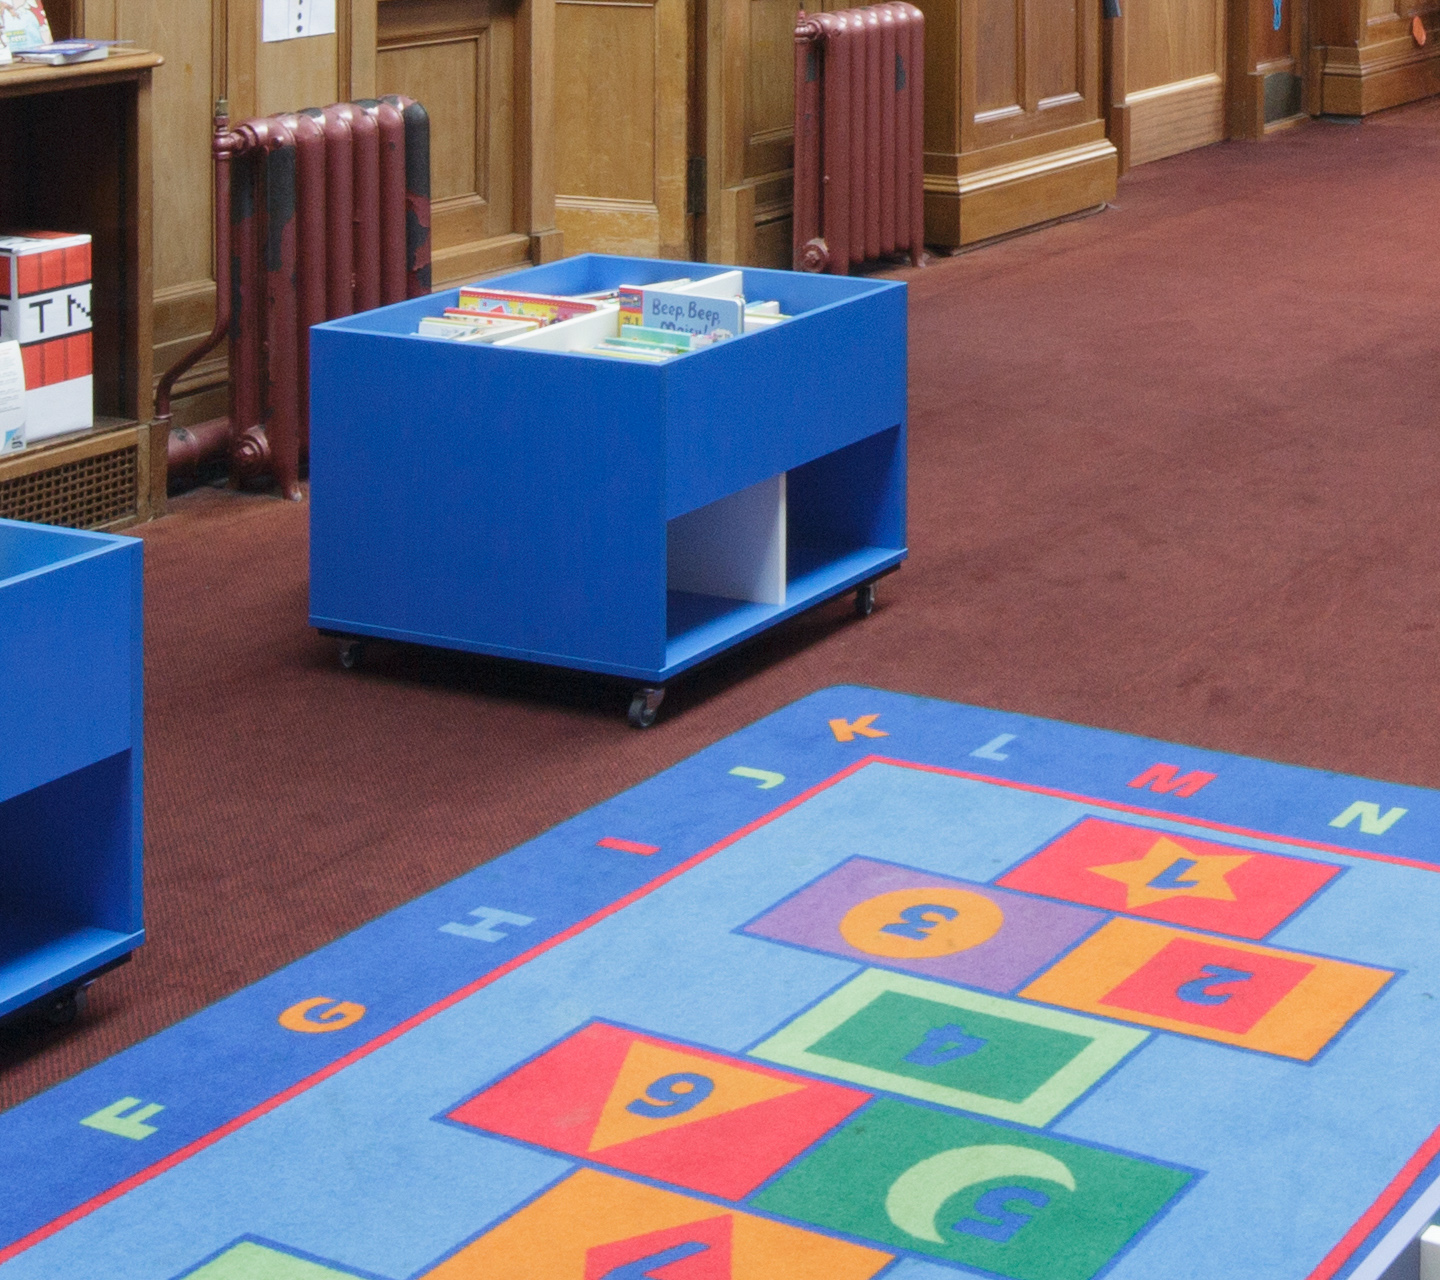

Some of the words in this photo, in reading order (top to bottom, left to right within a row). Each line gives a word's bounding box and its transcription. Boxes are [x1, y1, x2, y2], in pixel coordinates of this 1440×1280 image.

[652, 298, 685, 321] Beep,
[687, 301, 721, 327] Beep,
[827, 713, 891, 744] K
[967, 733, 1019, 762] L
[728, 765, 787, 789] J
[1126, 764, 1219, 799] M
[1328, 800, 1408, 837] N
[595, 836, 662, 857] I
[1145, 856, 1203, 893] 1
[439, 905, 537, 943] H
[880, 902, 962, 941] 3
[1174, 962, 1257, 1008] 2
[277, 996, 367, 1034] G
[902, 1021, 992, 1068] 4
[79, 1096, 166, 1141] F
[950, 1184, 1053, 1241] 5
